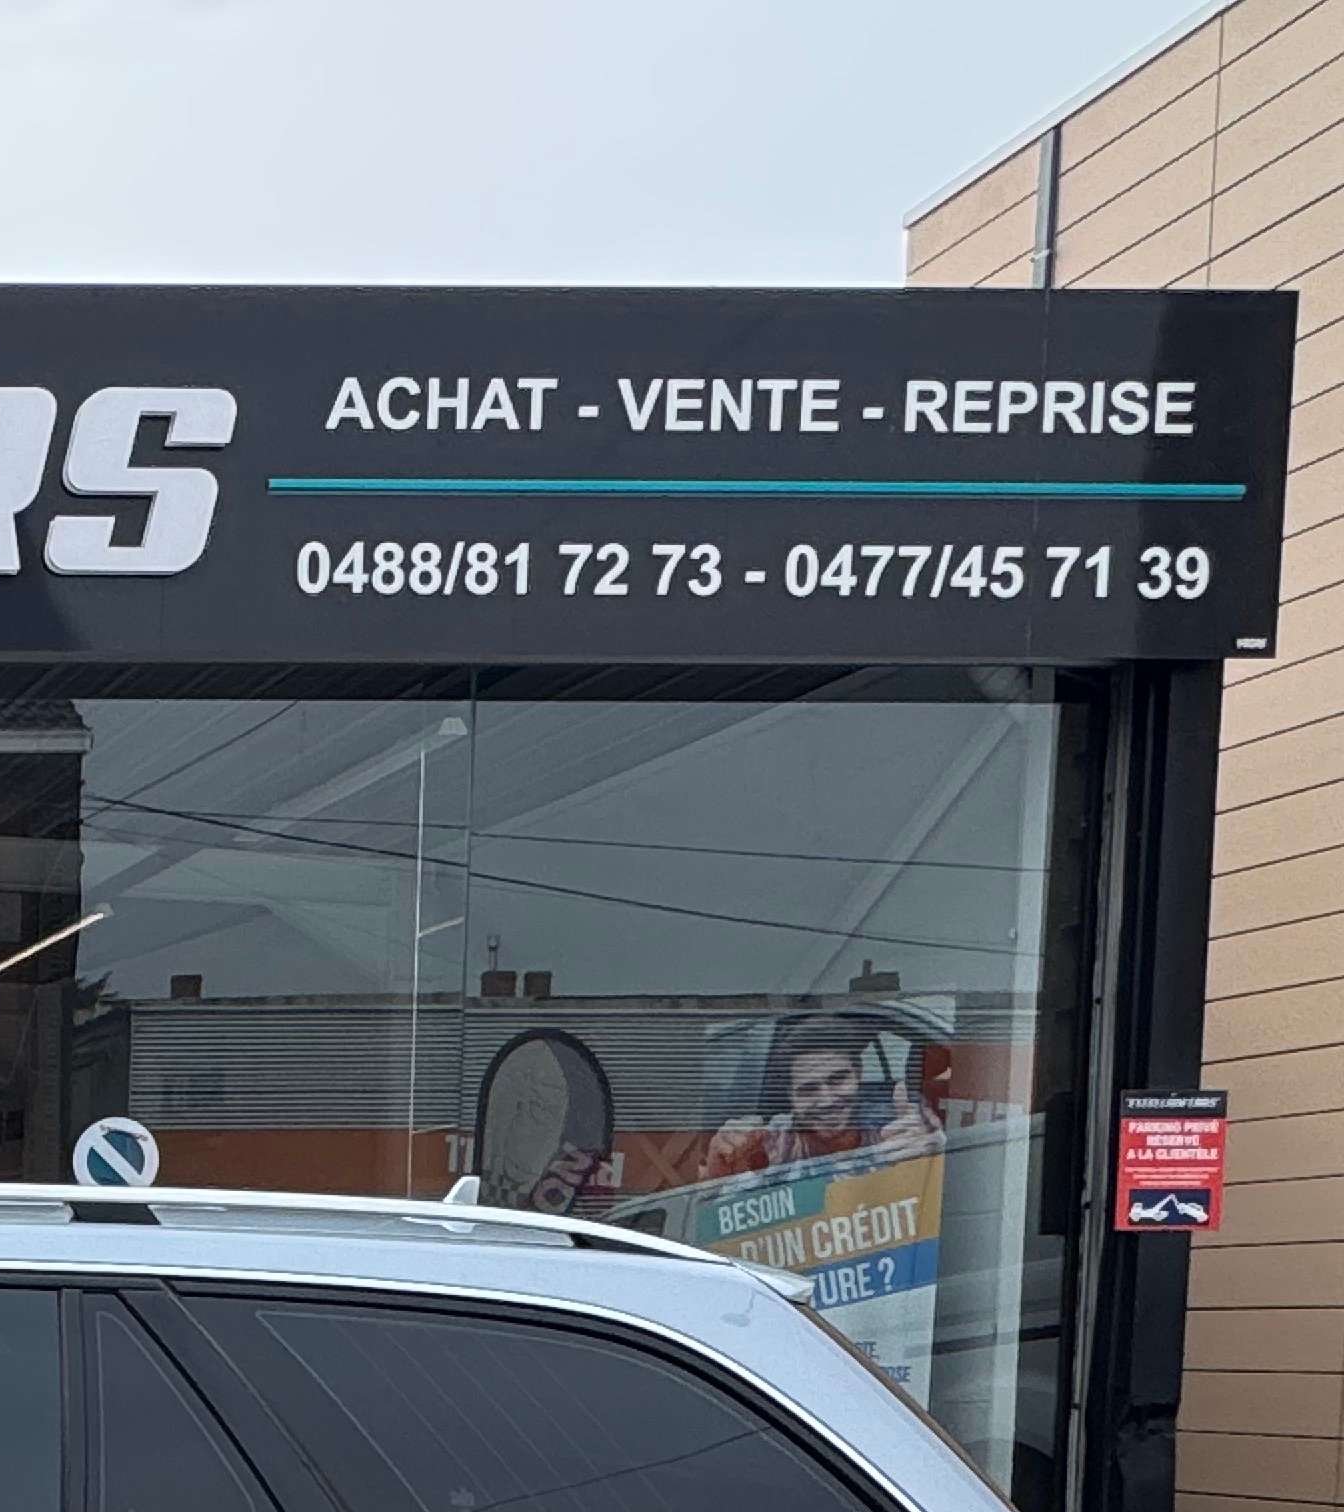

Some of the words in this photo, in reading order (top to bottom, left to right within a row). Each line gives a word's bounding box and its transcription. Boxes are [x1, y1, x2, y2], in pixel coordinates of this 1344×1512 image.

[325, 376, 559, 431] ACHAT
[578, 405, 600, 419] -
[617, 378, 841, 433] VENTE
[862, 406, 884, 420] -
[904, 380, 1196, 436] REPRISE
[297, 540, 531, 596] 0488/81
[558, 542, 630, 597] 72
[652, 543, 723, 597] 73
[744, 570, 767, 584] -
[785, 544, 1025, 599] 0477/45
[1046, 546, 1111, 599] 71
[1137, 546, 1210, 600] 39
[718, 1185, 796, 1236] BESOIN
[739, 1227, 806, 1269] D'UN
[812, 1196, 919, 1259] CRÉDIT
[877, 1256, 896, 1293] ?
